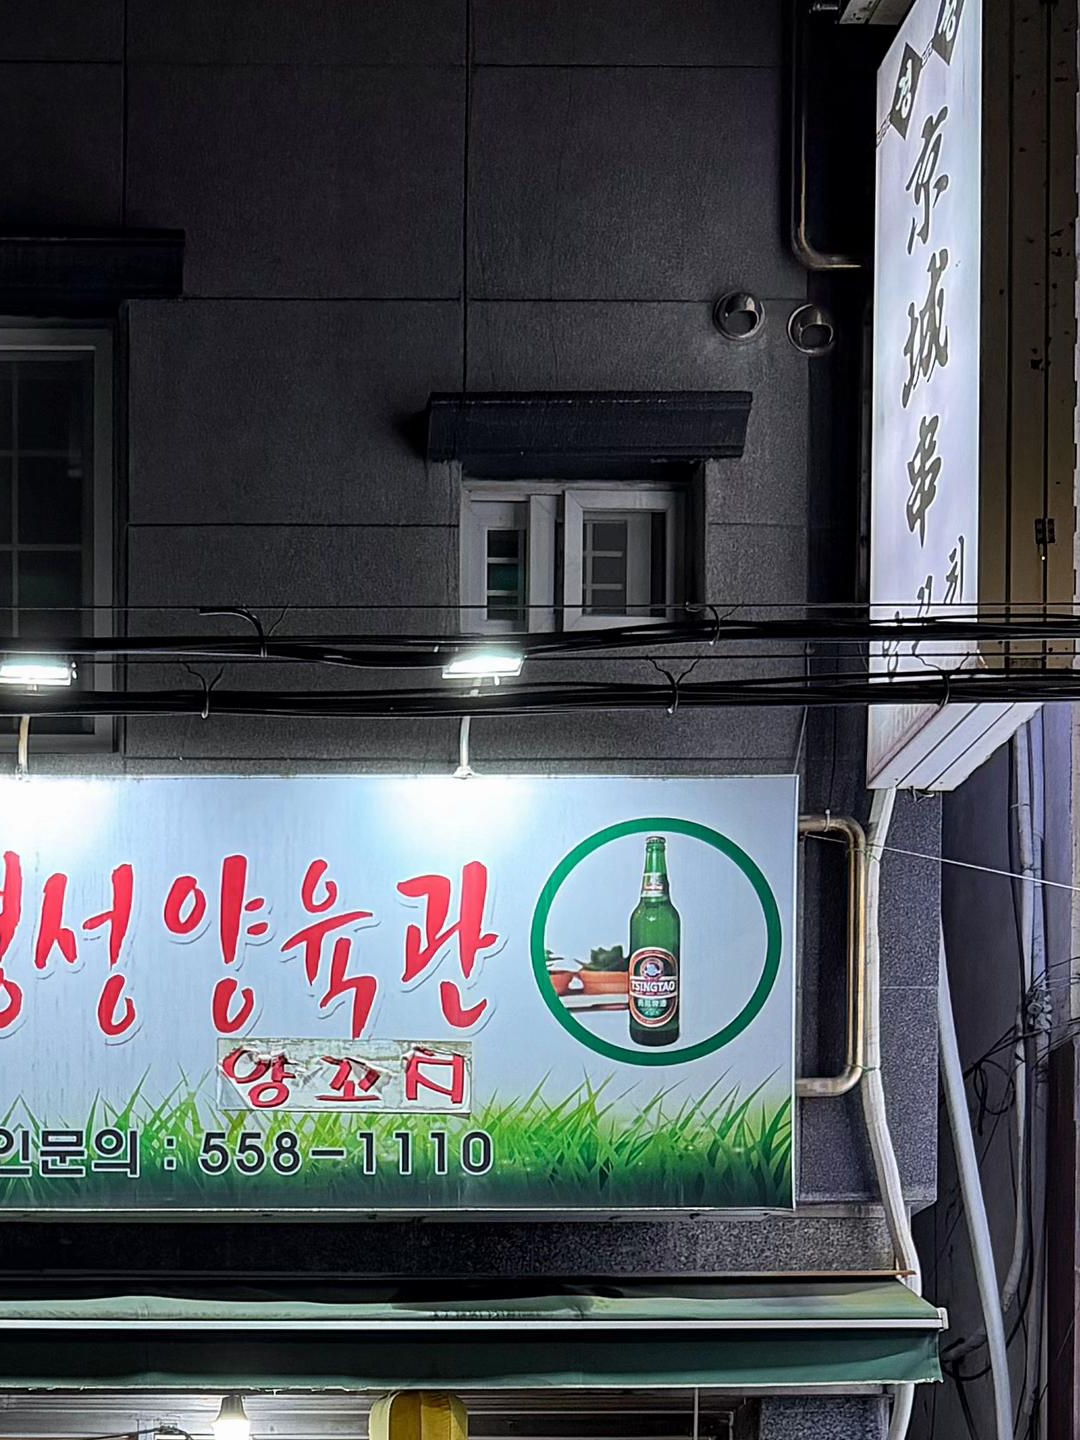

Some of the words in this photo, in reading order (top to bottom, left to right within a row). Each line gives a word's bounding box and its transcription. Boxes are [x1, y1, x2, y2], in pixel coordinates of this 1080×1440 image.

[903, 106, 950, 547] 京城串
[631, 980, 675, 991] TSINGTAO
[199, 1131, 493, 1175] 558-1110
